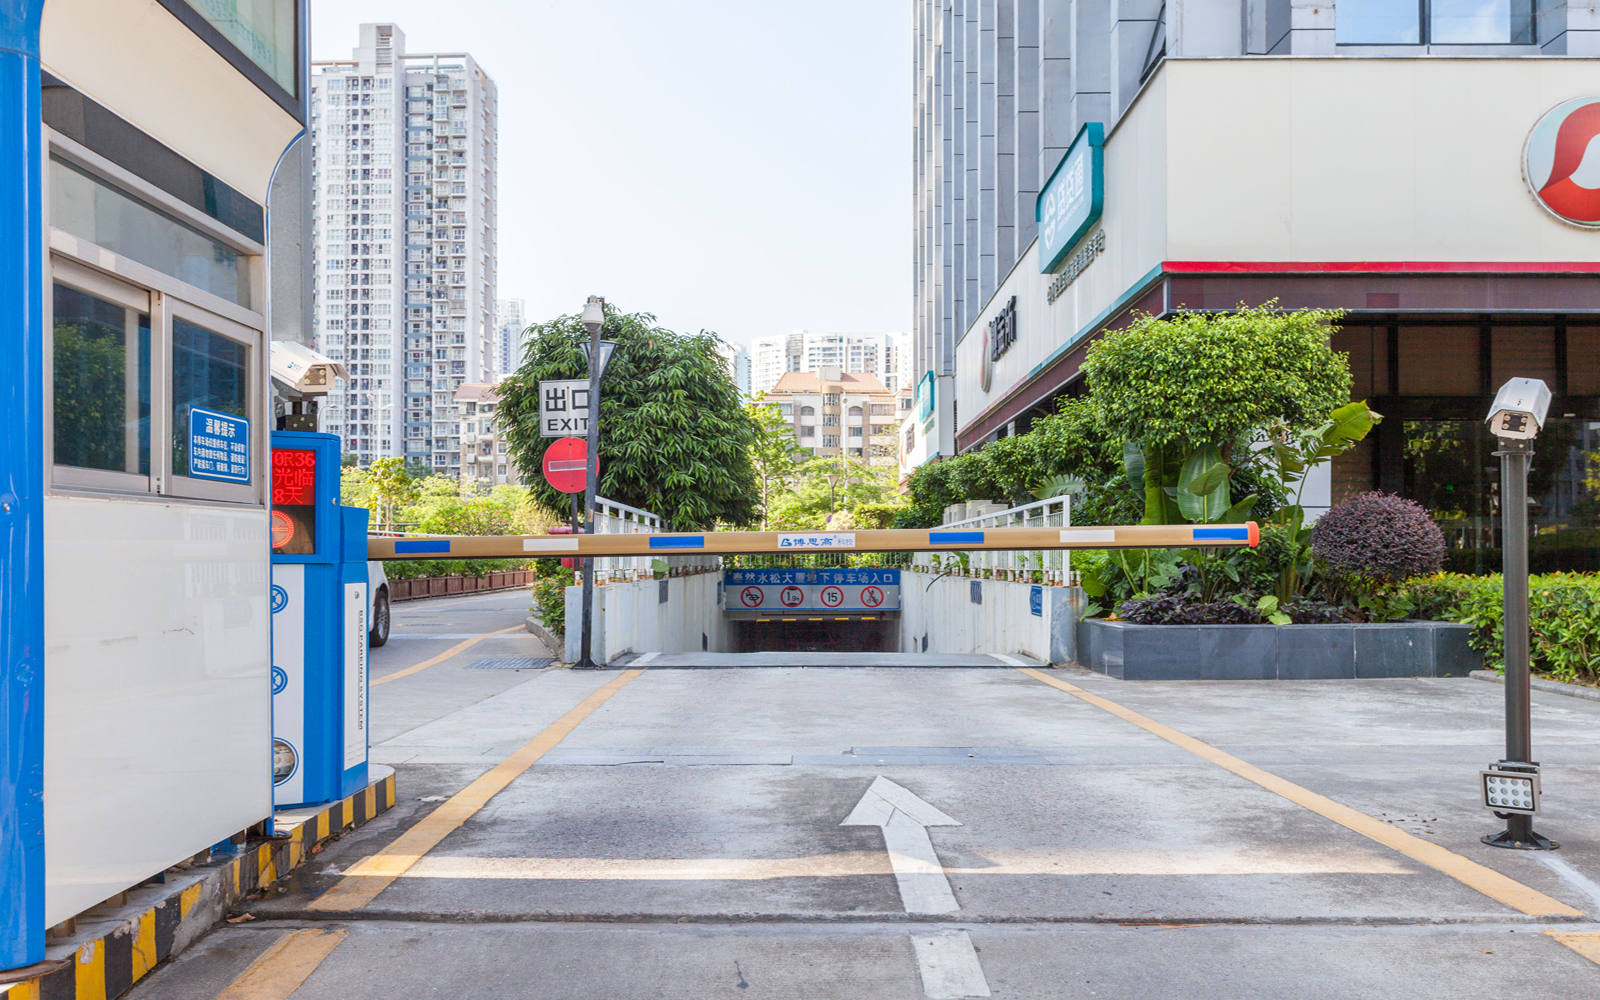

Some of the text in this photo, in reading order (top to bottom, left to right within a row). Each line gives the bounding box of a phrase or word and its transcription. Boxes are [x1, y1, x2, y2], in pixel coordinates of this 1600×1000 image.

[546, 388, 590, 412] 出口
[205, 418, 236, 438] 温馨提示
[547, 418, 589, 431] EXIT
[271, 451, 316, 467] 0R36
[273, 467, 315, 487] 光临
[827, 592, 838, 602] 15
